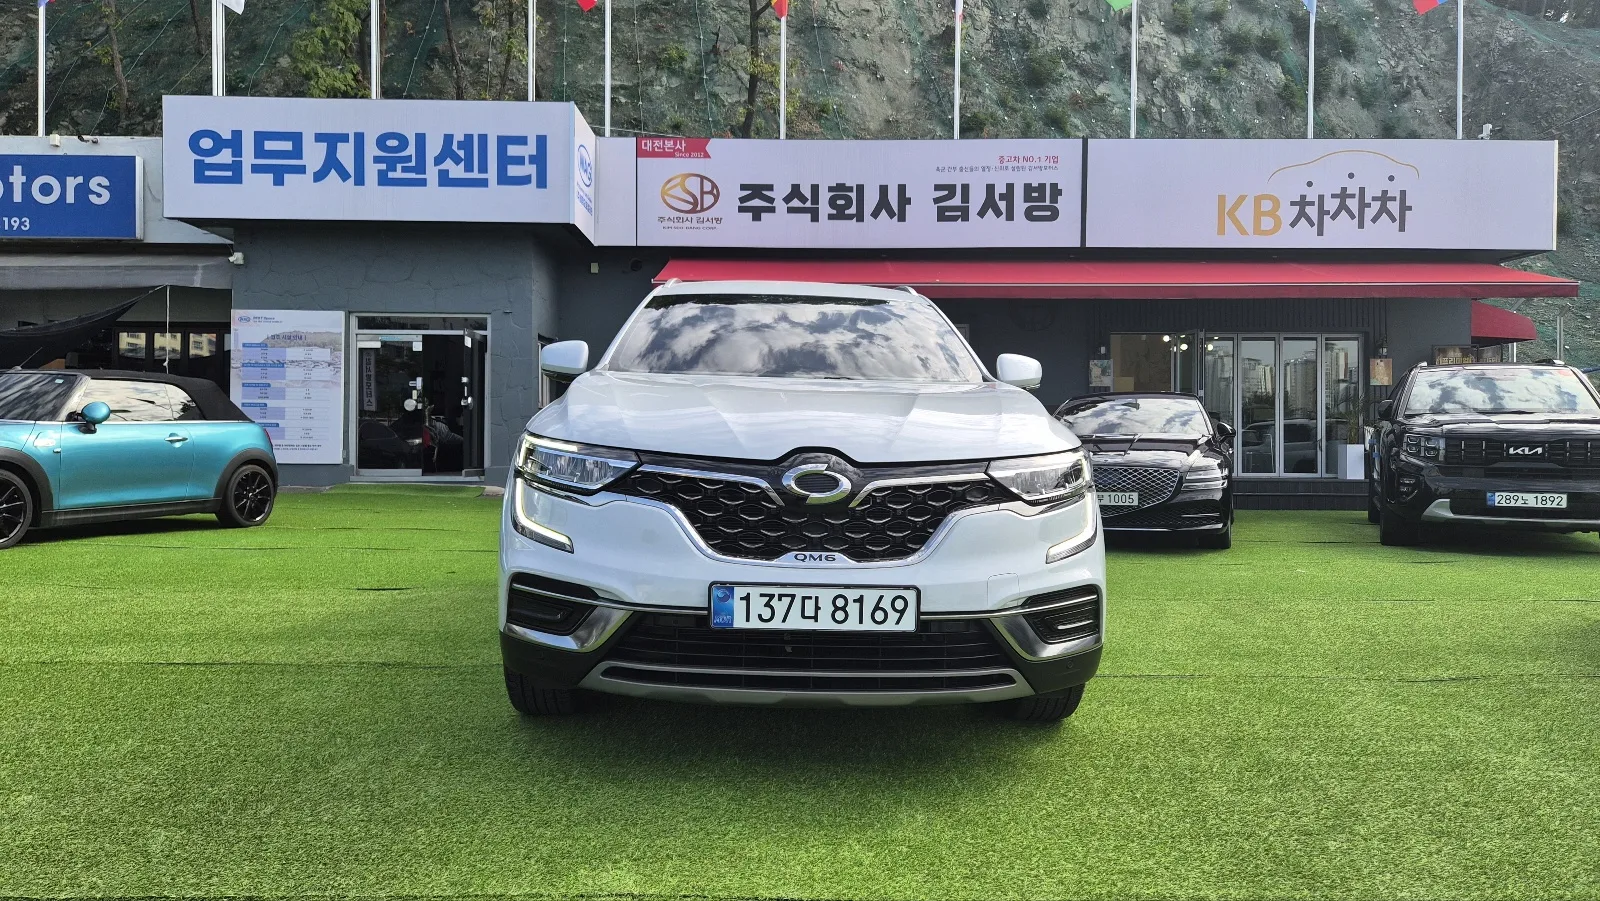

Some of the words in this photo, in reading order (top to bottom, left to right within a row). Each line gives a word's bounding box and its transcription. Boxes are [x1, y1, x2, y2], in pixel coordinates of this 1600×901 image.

[641, 139, 686, 152] 대전본사
[188, 129, 548, 189] 업무지원센터
[998, 155, 1020, 164] 중고차
[1044, 155, 1059, 164] 기업
[0, 165, 111, 205] tors
[737, 182, 912, 223] 주식회사
[932, 182, 1064, 223] 김서방
[1216, 193, 1283, 237] KB
[1288, 171, 1413, 237] 차차차
[657, 216, 693, 224] 주식회사
[696, 216, 723, 225] 김서방
[1508, 446, 1543, 455] KIA
[1108, 494, 1134, 504] 1005
[1496, 494, 1529, 505] 289노
[1533, 495, 1564, 507] 1892
[794, 552, 836, 562] QM6
[739, 592, 821, 624] 137다
[831, 593, 909, 626] 8169
